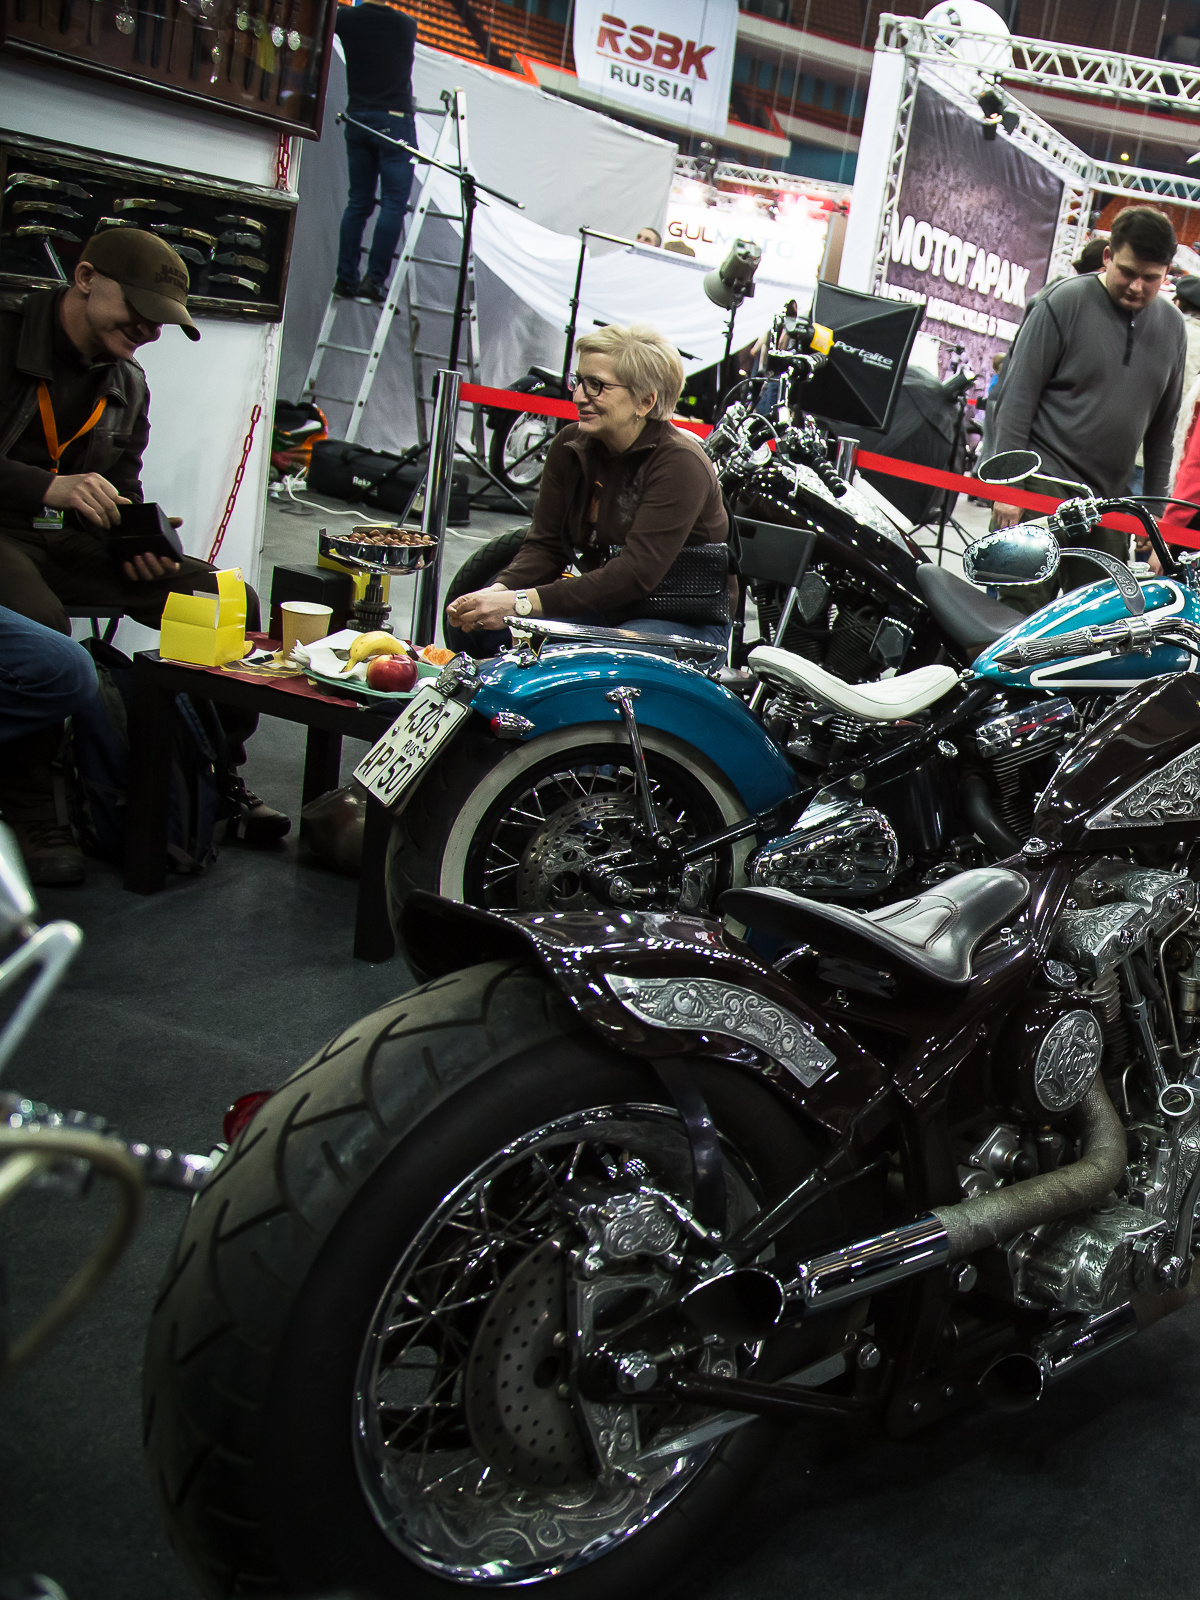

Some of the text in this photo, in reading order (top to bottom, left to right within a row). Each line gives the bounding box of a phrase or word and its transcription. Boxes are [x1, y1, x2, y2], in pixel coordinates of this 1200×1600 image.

[597, 13, 716, 81] RSBK
[610, 63, 693, 105] RUSSIA
[668, 221, 795, 259] GULMTO
[833, 341, 893, 365] Portalite
[404, 699, 451, 743] 4305
[402, 740, 419, 757] RUS
[377, 755, 412, 794] 50
